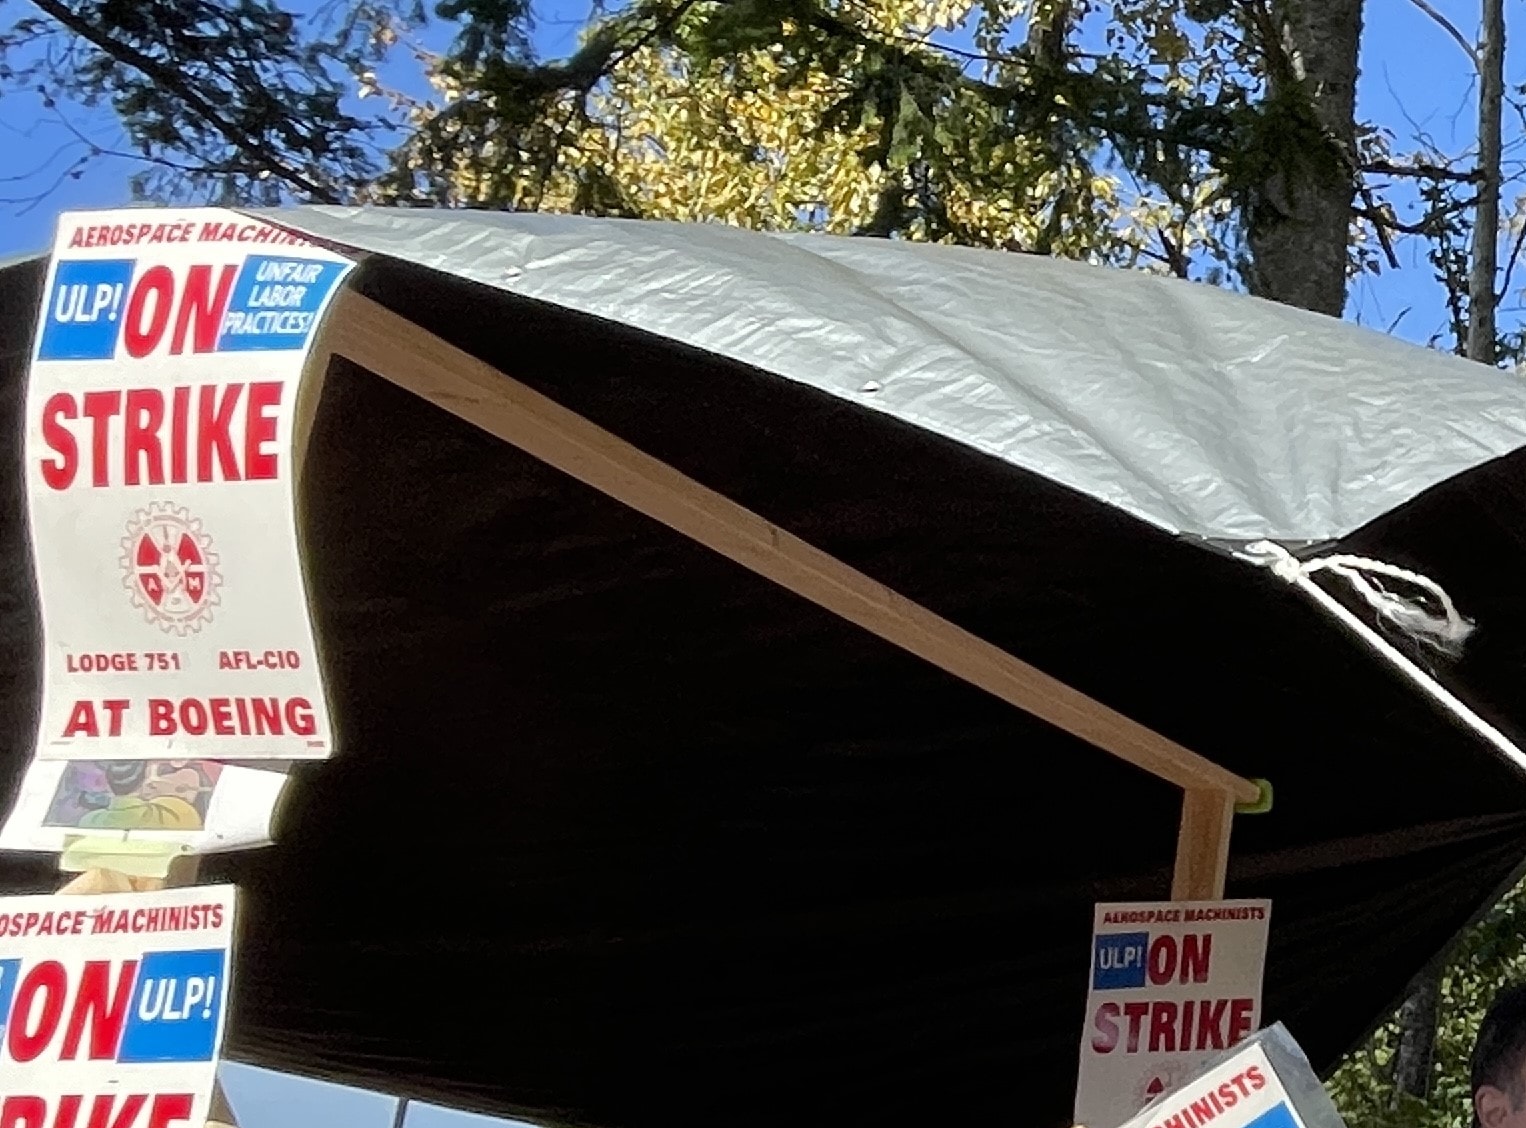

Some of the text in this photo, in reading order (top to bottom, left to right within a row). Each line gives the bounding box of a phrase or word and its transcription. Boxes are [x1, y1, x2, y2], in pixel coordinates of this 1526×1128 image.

[68, 223, 196, 248] AEROSPACE
[255, 261, 323, 284] UNFAIR
[55, 284, 123, 322] ULP!
[124, 265, 239, 359] ON
[247, 285, 308, 308] LABOR
[223, 312, 316, 334] PRACTICES!
[41, 381, 284, 491] STRIKE
[67, 651, 300, 673] LODGE 751 AFL-CIO
[61, 697, 316, 737] AT BOEING
[91, 903, 223, 934] MACHINISTS
[1103, 907, 1265, 924] AEROSPACE MACHINISTS
[1100, 946, 1142, 969] ULP!
[1148, 934, 1212, 985] ON
[8, 960, 139, 1063] ON
[139, 976, 215, 1021] ULP!
[1092, 998, 1254, 1053] STRIKE
